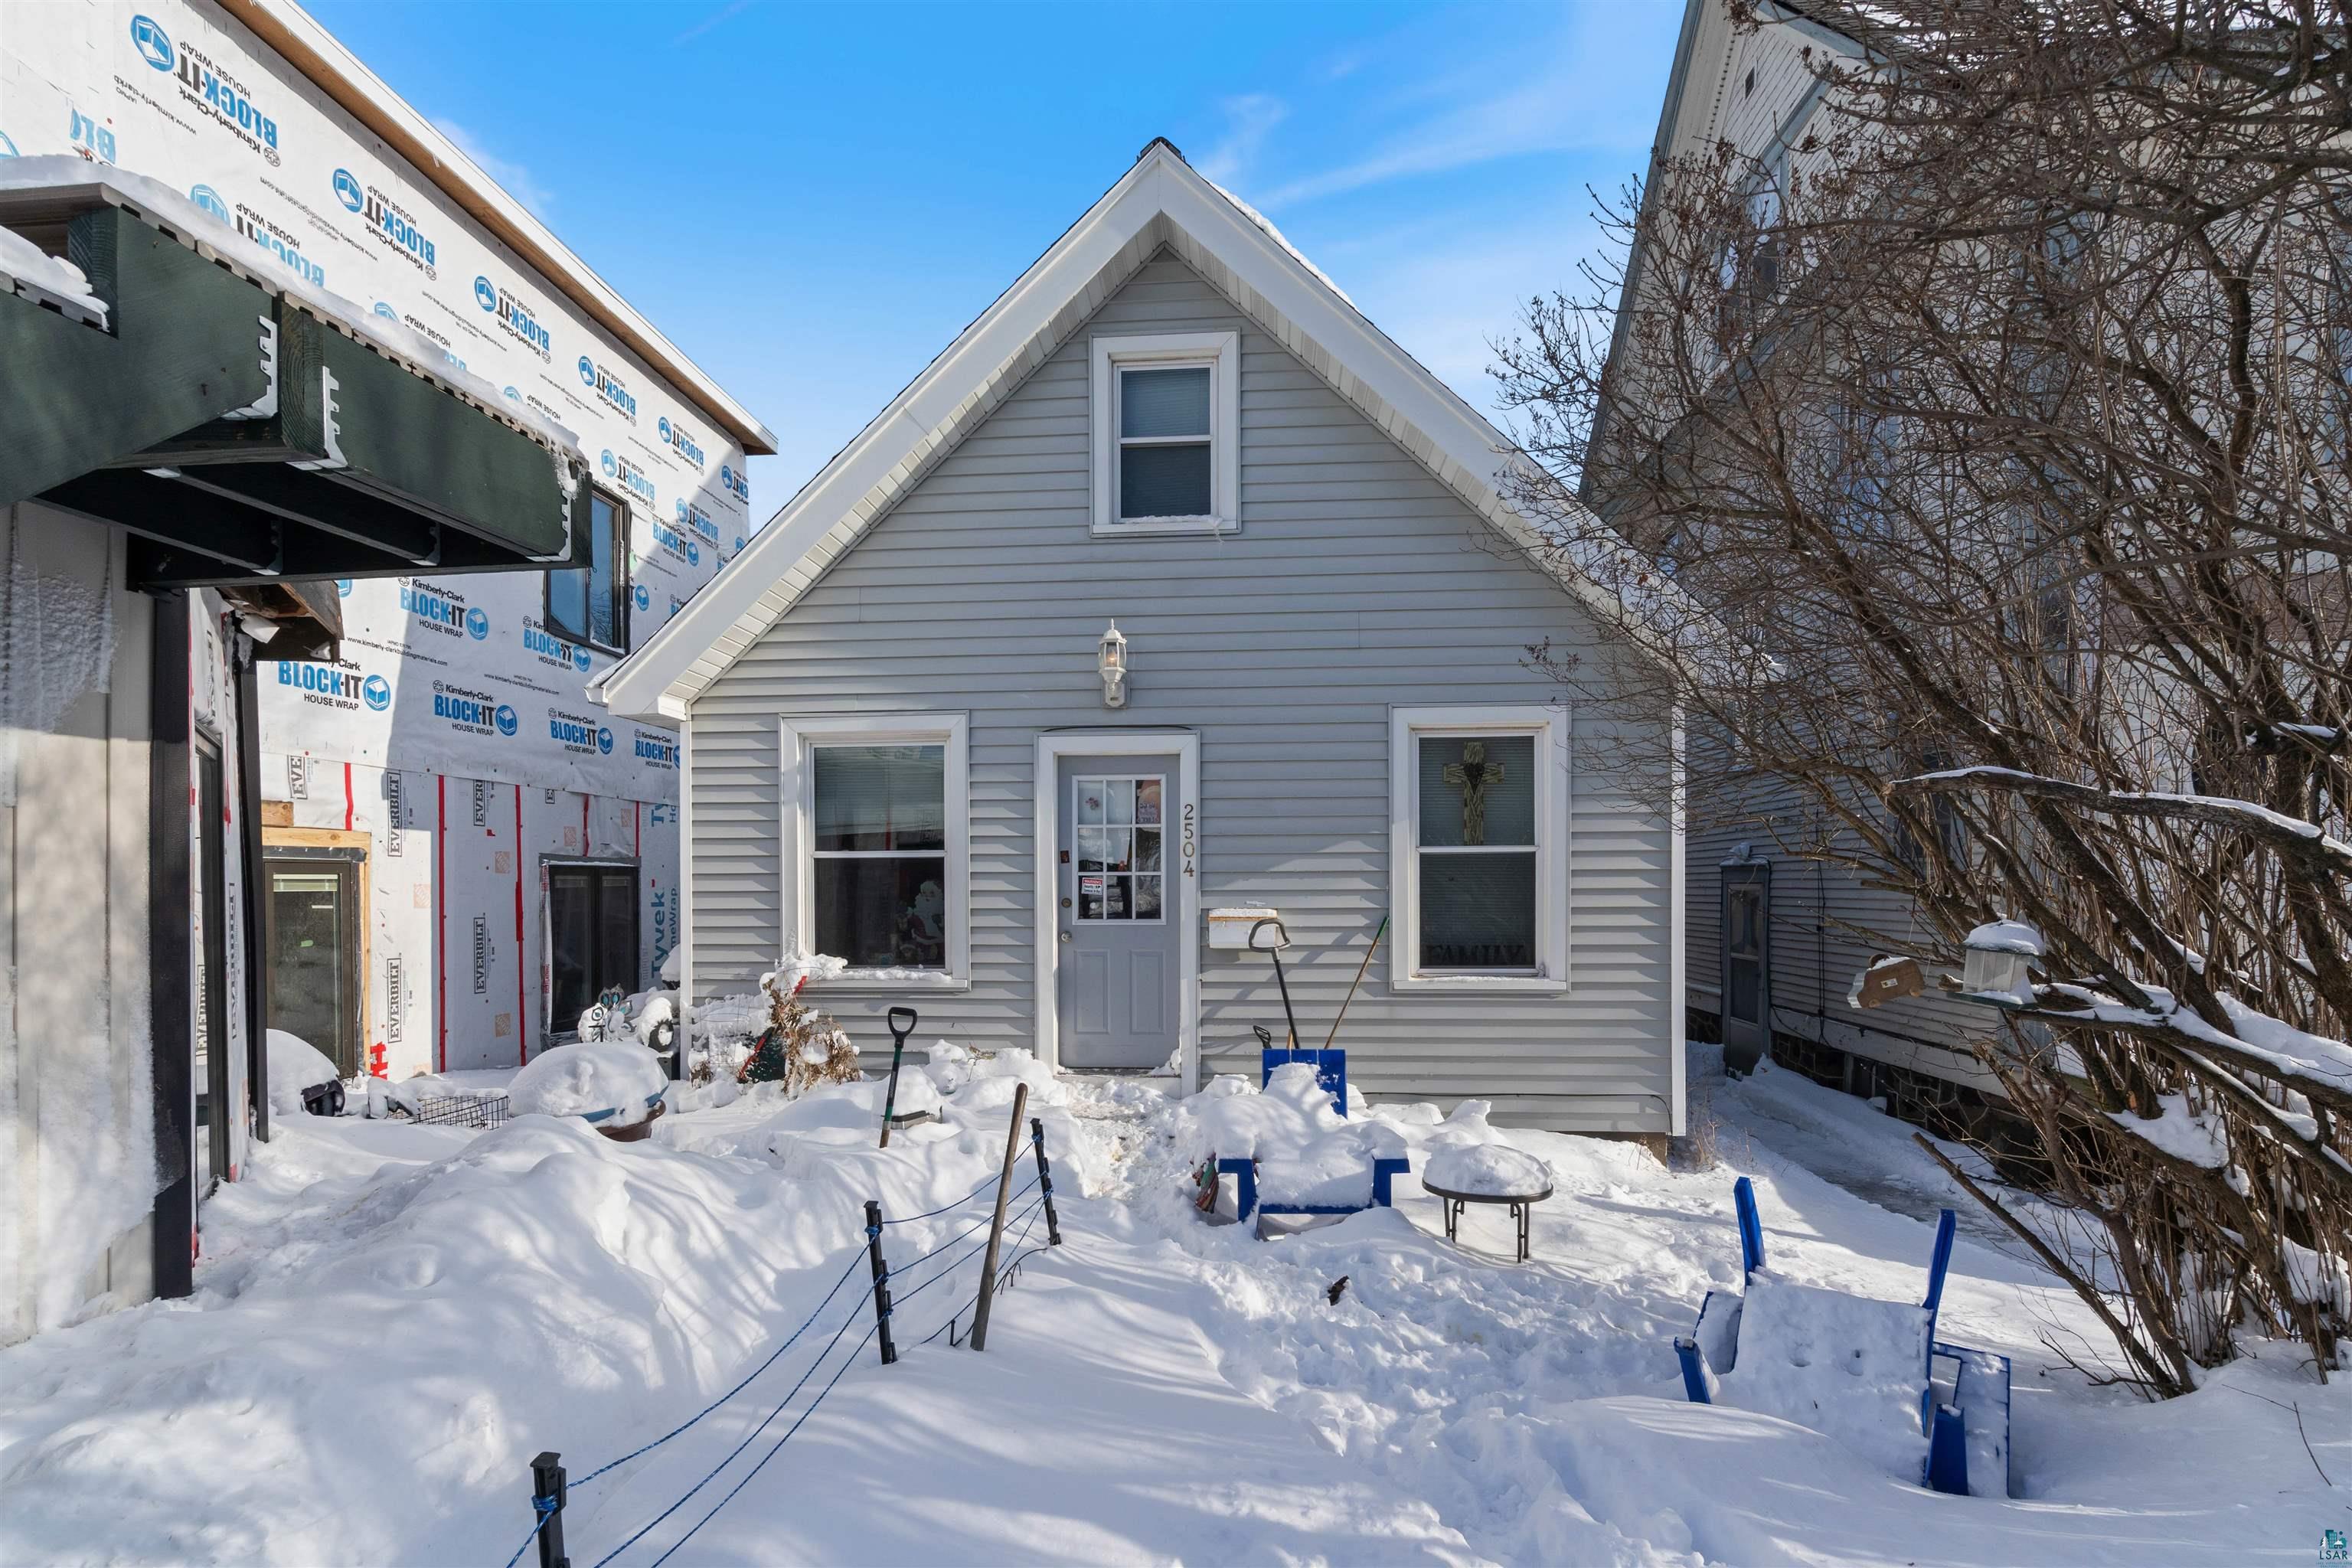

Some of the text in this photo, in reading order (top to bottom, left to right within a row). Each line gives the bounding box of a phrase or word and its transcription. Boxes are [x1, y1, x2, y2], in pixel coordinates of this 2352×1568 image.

[179, 41, 251, 100] HOUSE WRAP
[179, 85, 262, 154] Kimberly-Clark
[236, 202, 266, 227] WRAP
[368, 185, 416, 227] HOUSE WRAP
[268, 220, 300, 249] HOUSE
[365, 223, 423, 271] Kimberly-Clark
[499, 287, 535, 318] HOUSE WRAP
[404, 314, 426, 332] WRAP
[426, 327, 451, 348] HOUSE
[527, 394, 561, 421] HOUSE WRAP
[412, 578, 465, 603] Kimberly-Clark
[419, 619, 463, 638] HOUSE WRAP
[538, 655, 573, 671] HOUSE WRAP
[304, 693, 359, 710] HOUSE WRAP
[446, 684, 494, 702] Kimberly-Clark
[452, 723, 494, 736] HOUSE WRAP
[565, 744, 596, 755] HOUSE WRAP
[389, 775, 400, 854] EVERBILT
[1183, 804, 1195, 877] 2504
[669, 889, 678, 949] meWrap
[651, 892, 668, 978] Tyvek
[475, 920, 485, 991] EVERBILT
[390, 962, 400, 1040] EVERBILT
